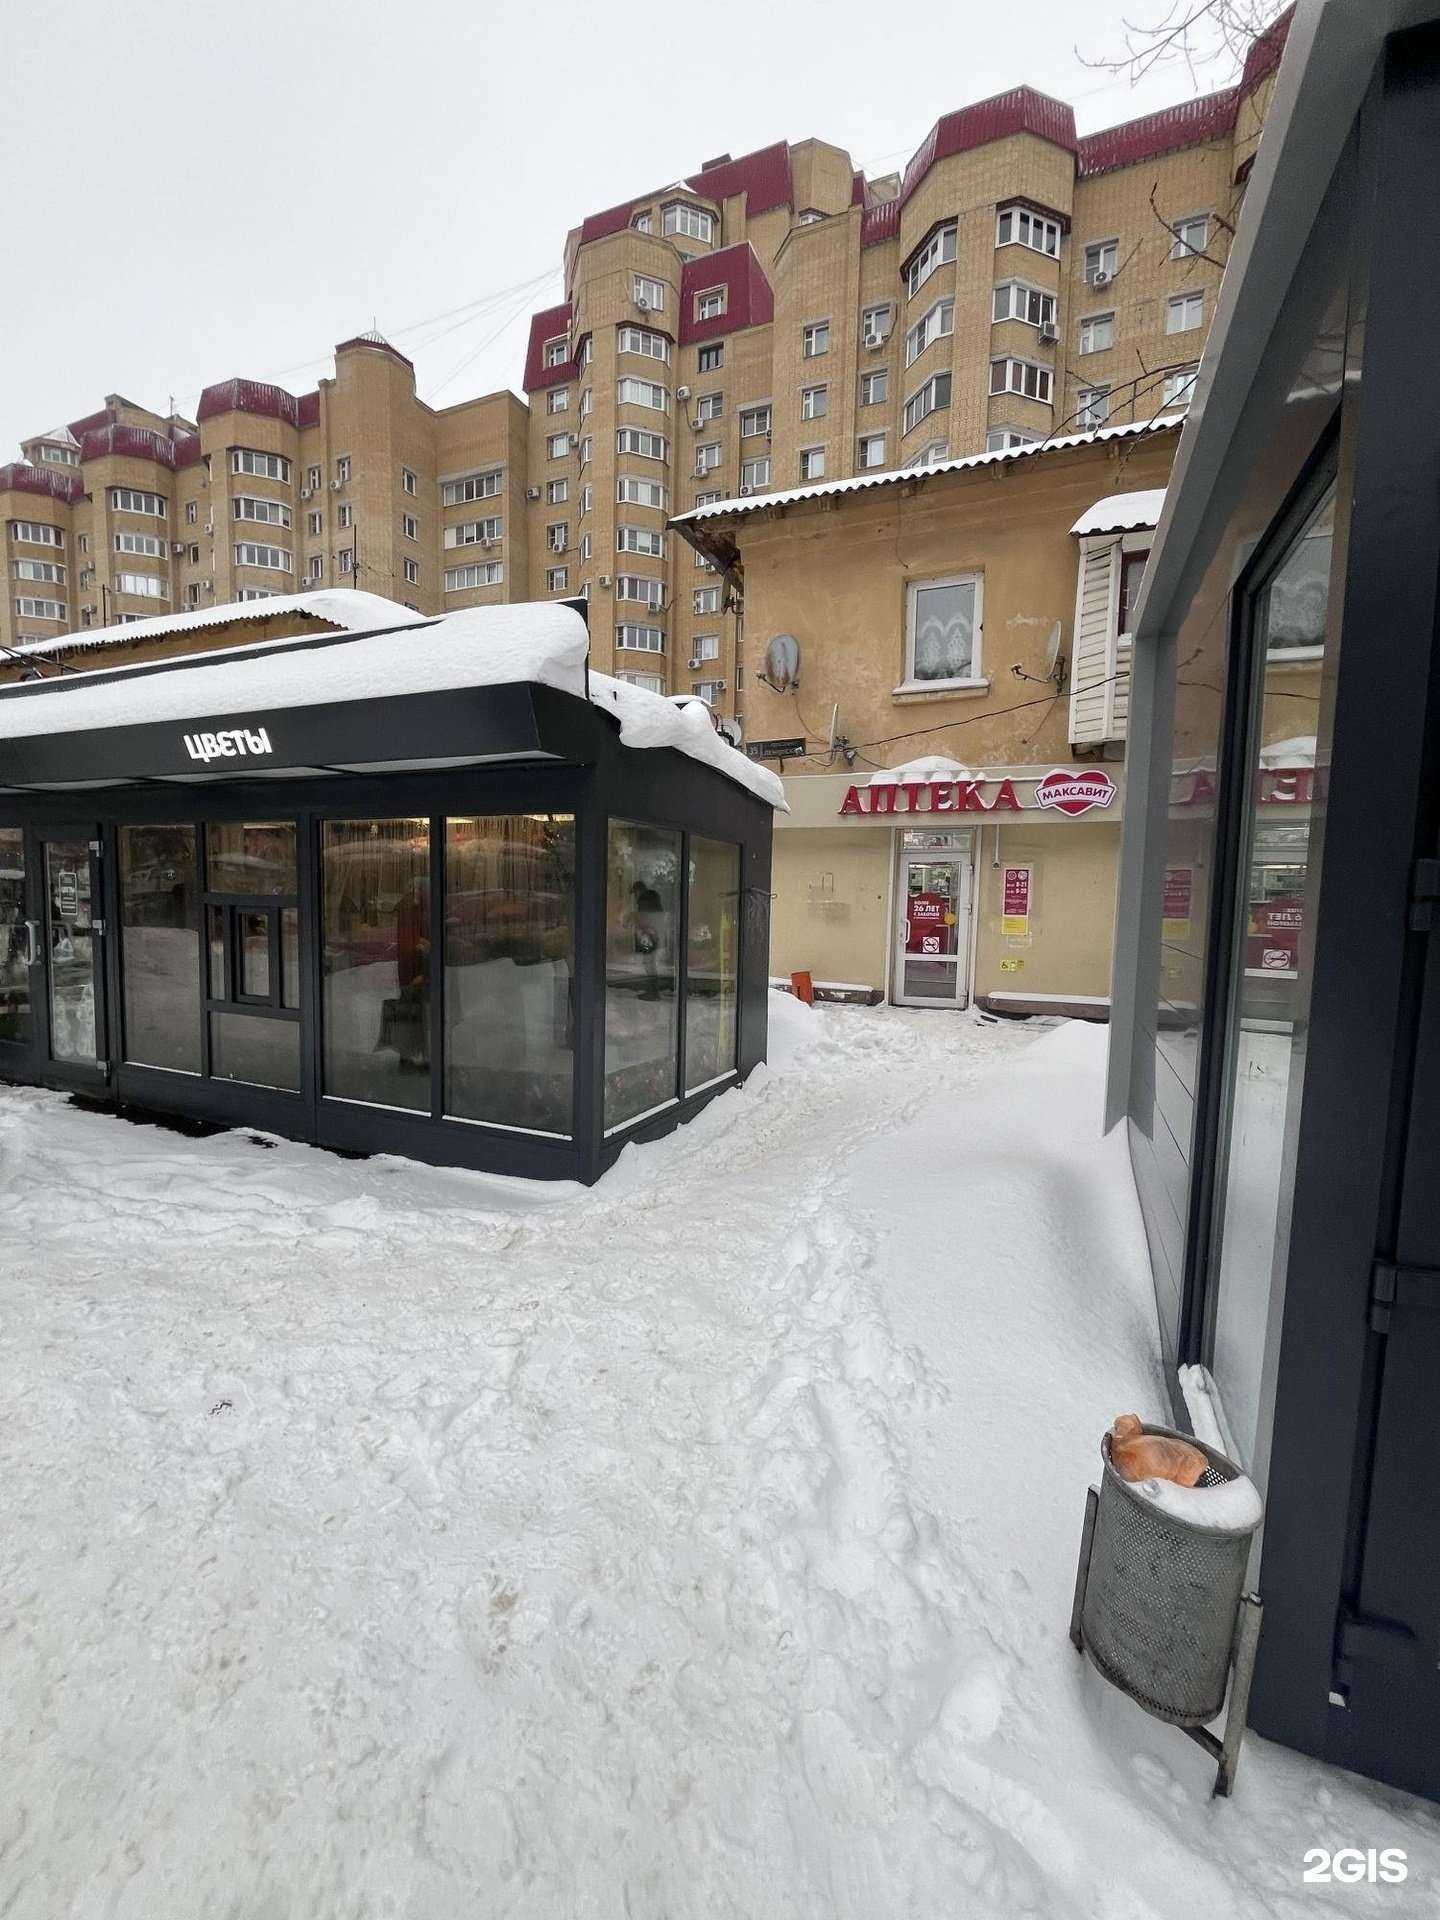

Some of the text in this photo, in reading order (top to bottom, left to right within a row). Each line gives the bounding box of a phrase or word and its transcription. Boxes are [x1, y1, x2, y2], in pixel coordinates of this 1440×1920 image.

[183, 728, 273, 763] ЦВЕТЫ
[837, 778, 1025, 815] АПТЕКА
[1042, 785, 1110, 801] МАКСАВИТ
